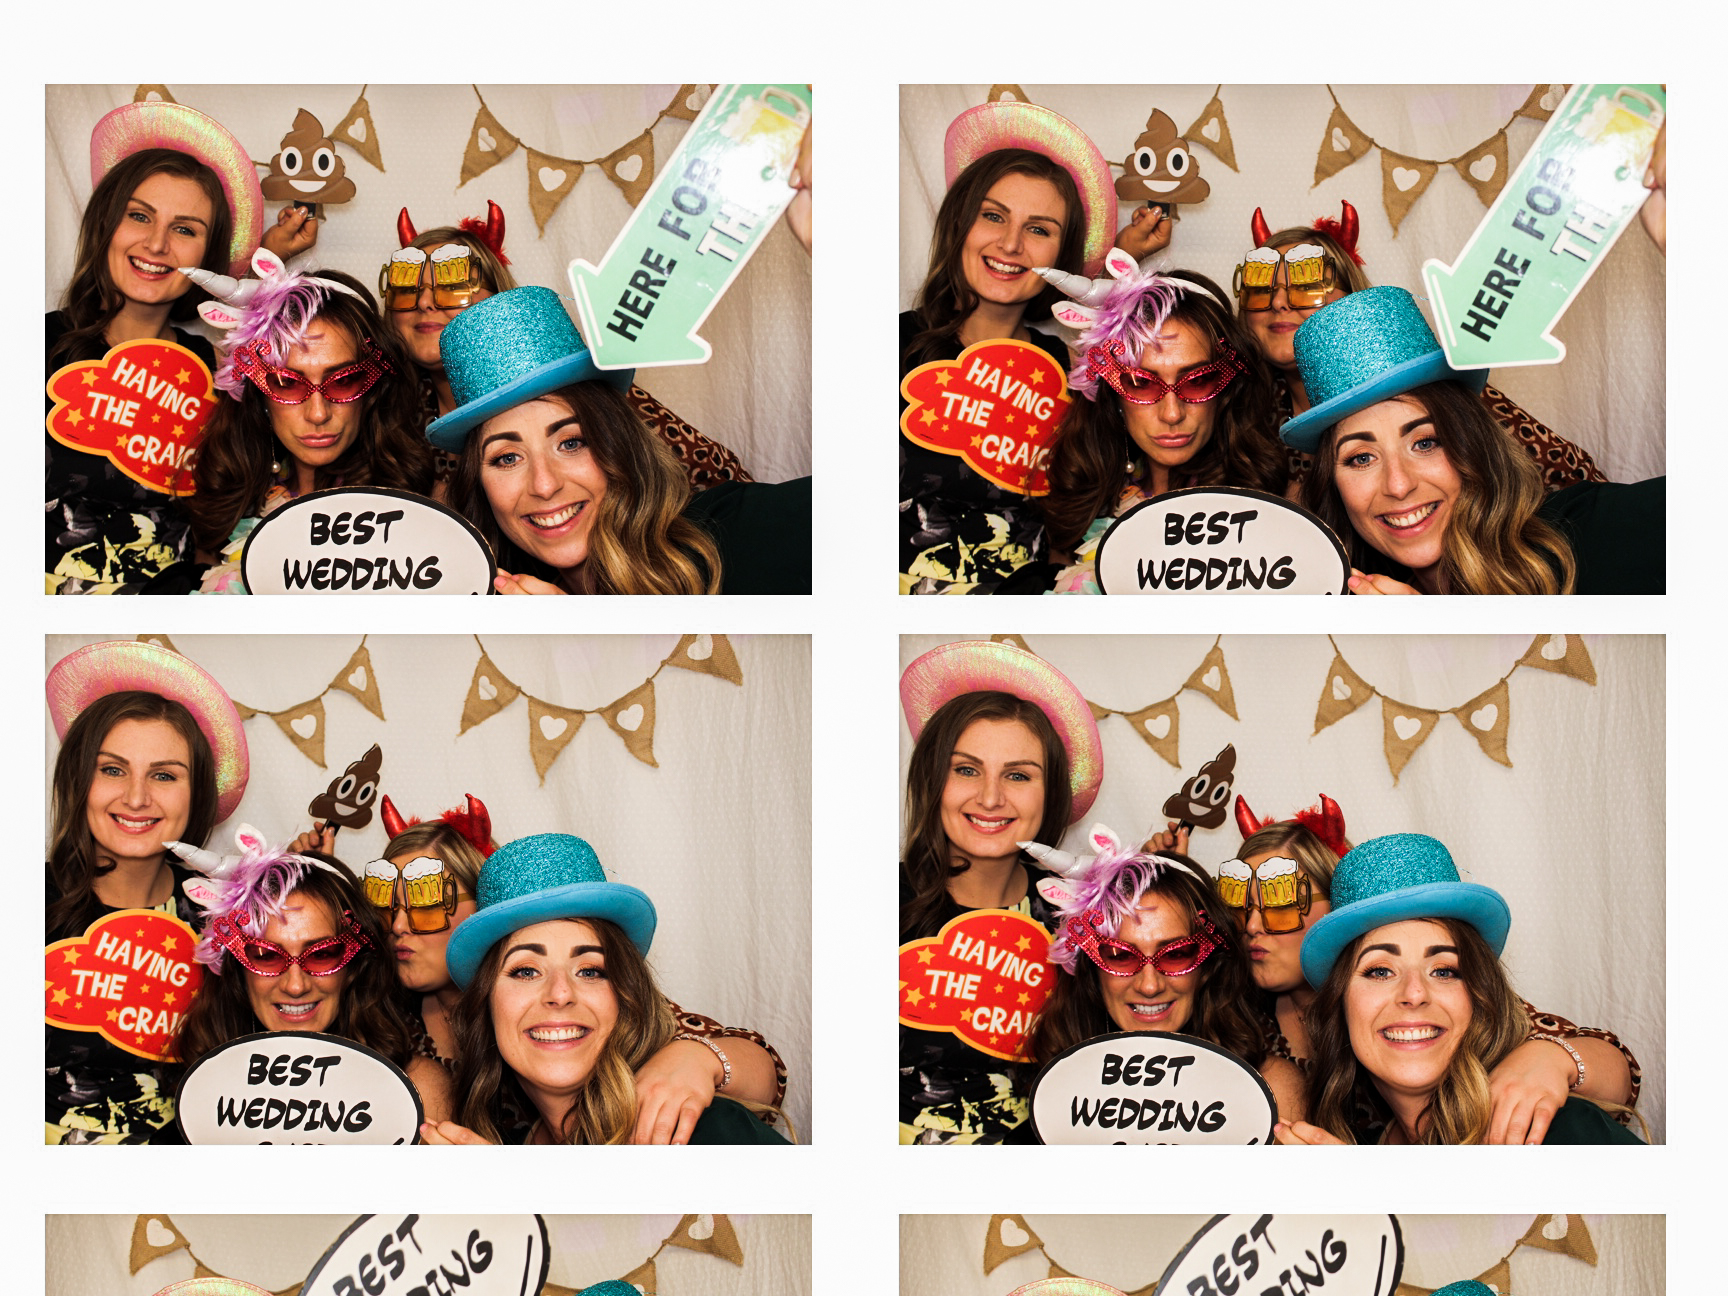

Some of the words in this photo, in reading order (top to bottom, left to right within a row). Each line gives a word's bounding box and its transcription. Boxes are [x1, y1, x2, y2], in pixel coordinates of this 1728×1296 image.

[606, 247, 678, 343] HERE
[1460, 247, 1532, 343] HERE
[112, 357, 201, 421] HAVING
[966, 357, 1055, 421] HAVING
[87, 391, 141, 428] THE
[941, 391, 995, 428] THE
[311, 510, 405, 545] BEST
[1165, 510, 1259, 545] BEST
[283, 556, 443, 591] WEDDING
[1137, 556, 1297, 591] WEDDING
[95, 931, 191, 987] HAVING
[949, 931, 1045, 987] HAVING
[71, 969, 128, 1001] THE
[925, 969, 982, 1001] THE
[248, 1053, 341, 1087] BEST
[1102, 1053, 1195, 1087] BEST
[217, 1096, 373, 1133] WEDDING
[1071, 1096, 1227, 1133] WEDDING
